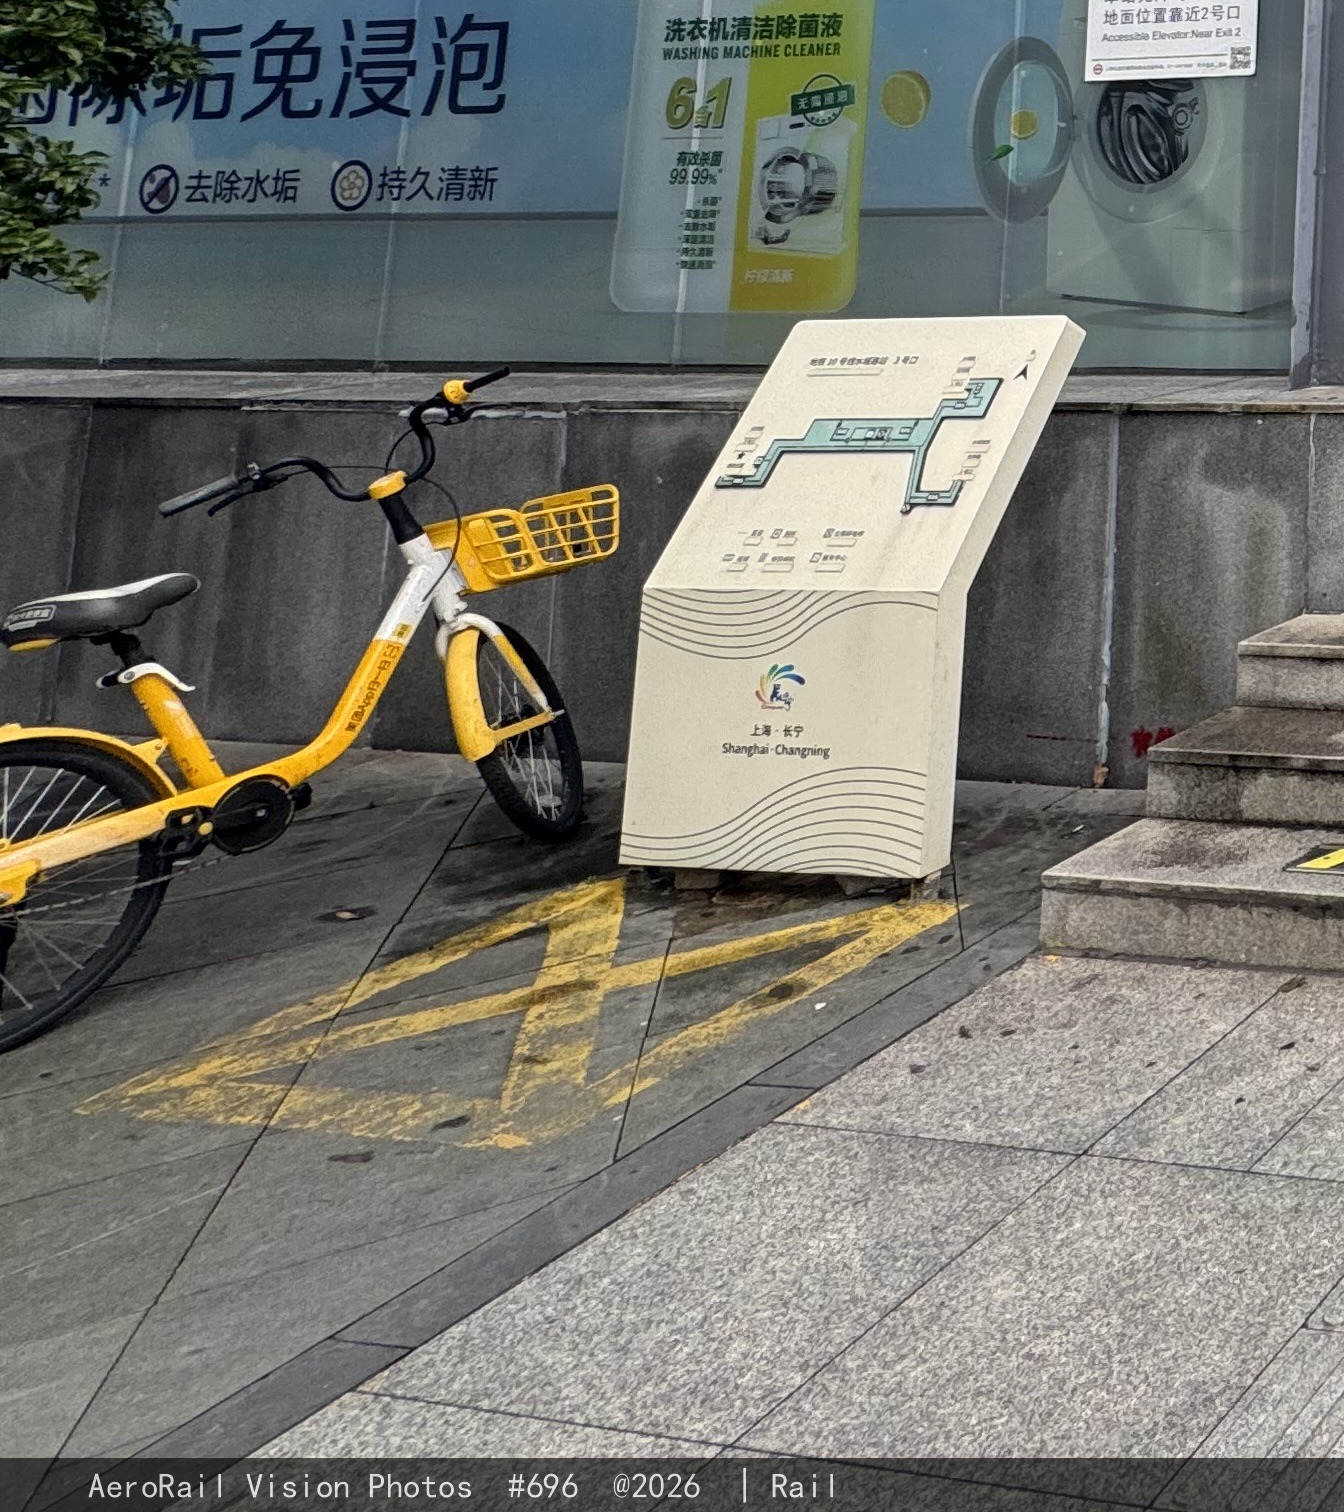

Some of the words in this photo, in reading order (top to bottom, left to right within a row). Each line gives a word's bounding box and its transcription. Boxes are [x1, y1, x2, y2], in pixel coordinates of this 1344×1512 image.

[664, 13, 844, 42] 洗衣机清洁除菌液
[1103, 5, 1241, 26] 地面位置靠近2号口
[663, 45, 719, 61] WASHING
[723, 44, 780, 59] MACHINE
[783, 42, 841, 58] CLEANER
[185, 169, 300, 205] 去除水垢
[377, 165, 498, 202] 持久清新
